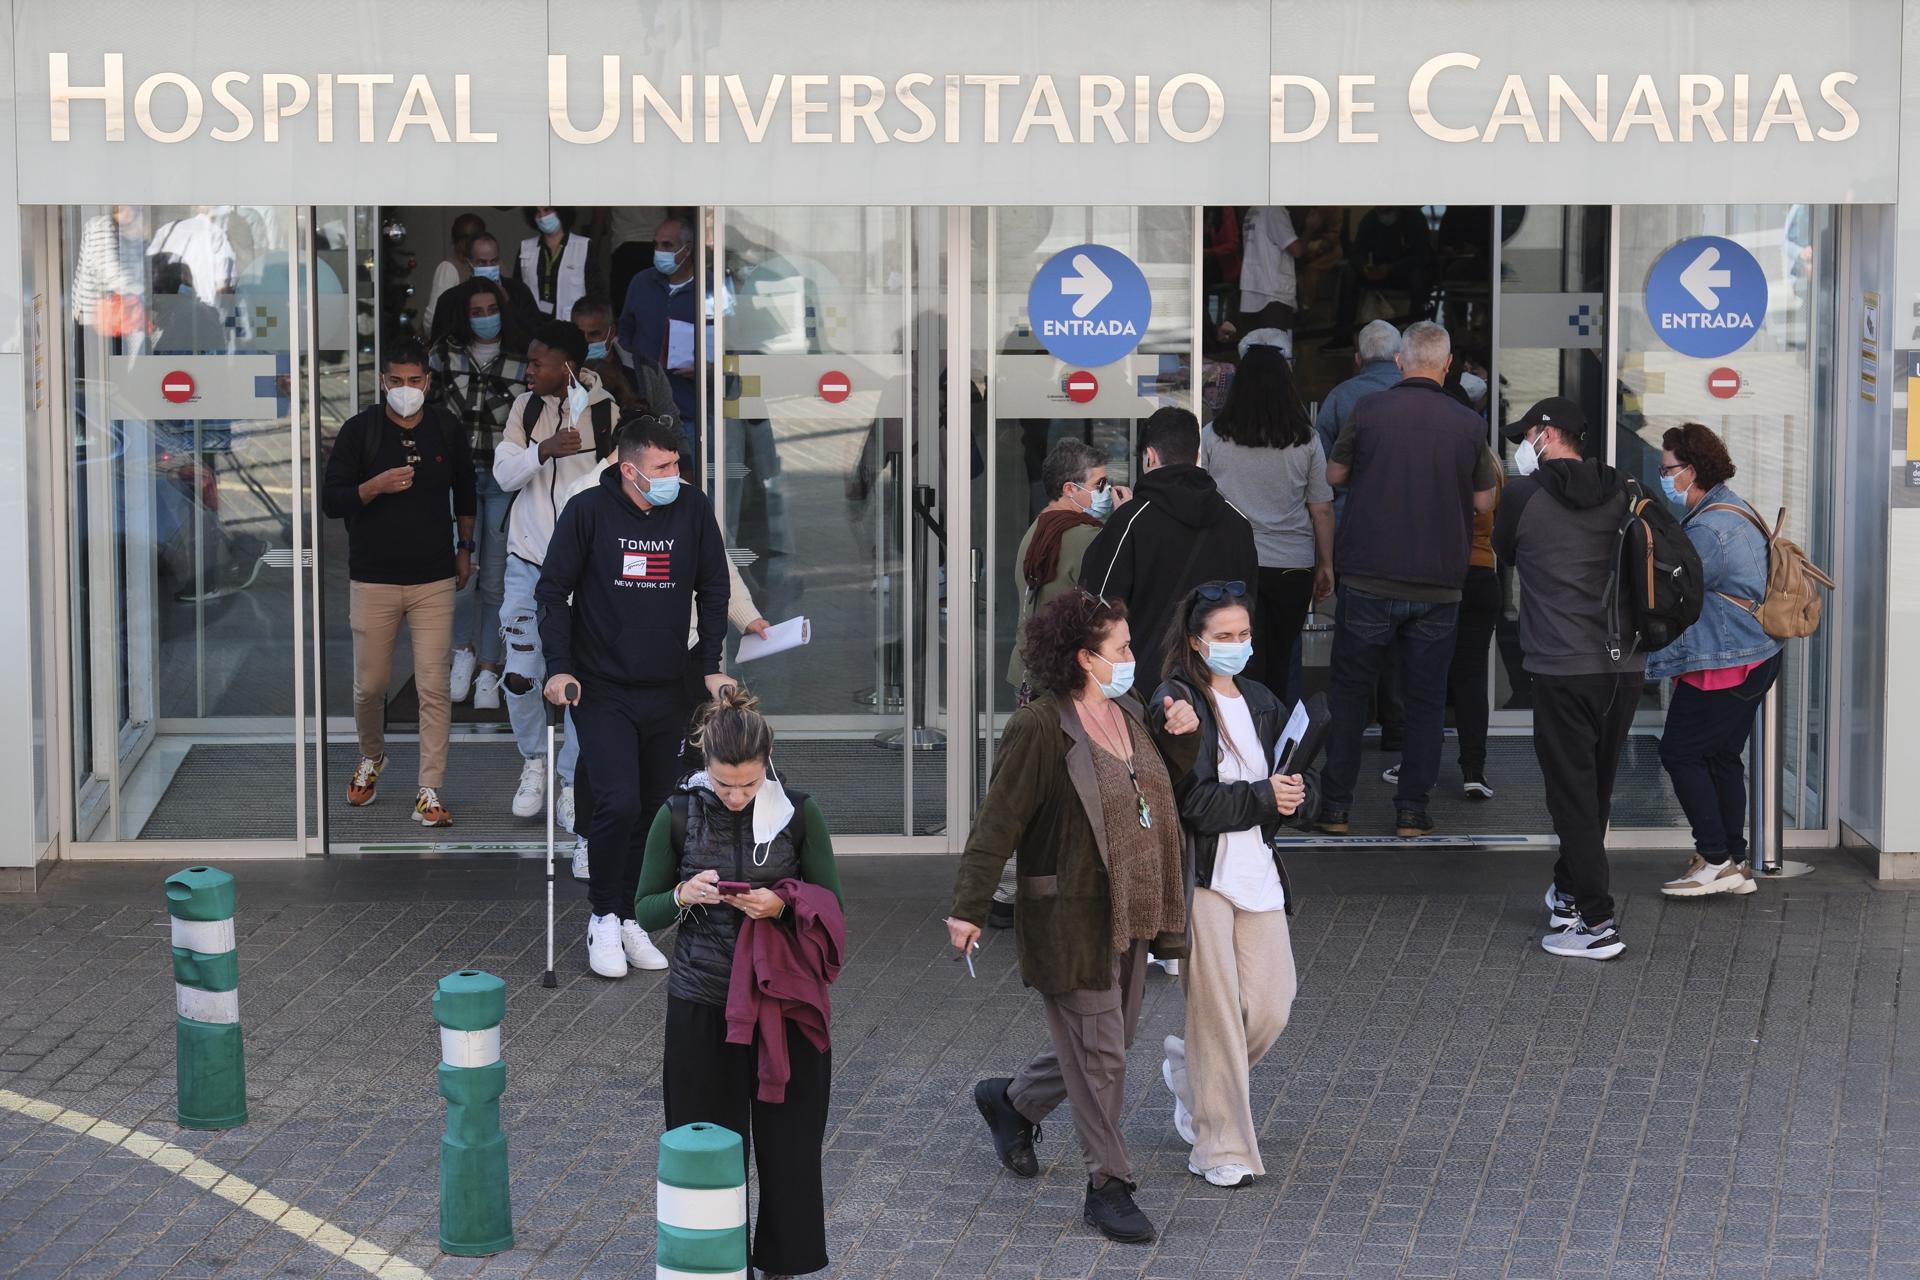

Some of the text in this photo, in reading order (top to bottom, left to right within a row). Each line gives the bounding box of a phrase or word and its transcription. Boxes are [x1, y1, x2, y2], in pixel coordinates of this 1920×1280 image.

[49, 52, 1860, 145] HOSPITAL UNIVERSITARIO DE CANARIAS
[1043, 319, 1138, 336] ENTRADA
[1661, 312, 1755, 329] ENTRADA
[617, 537, 675, 552] TOMMY
[614, 579, 634, 588] NEW
[636, 581, 657, 589] YORK
